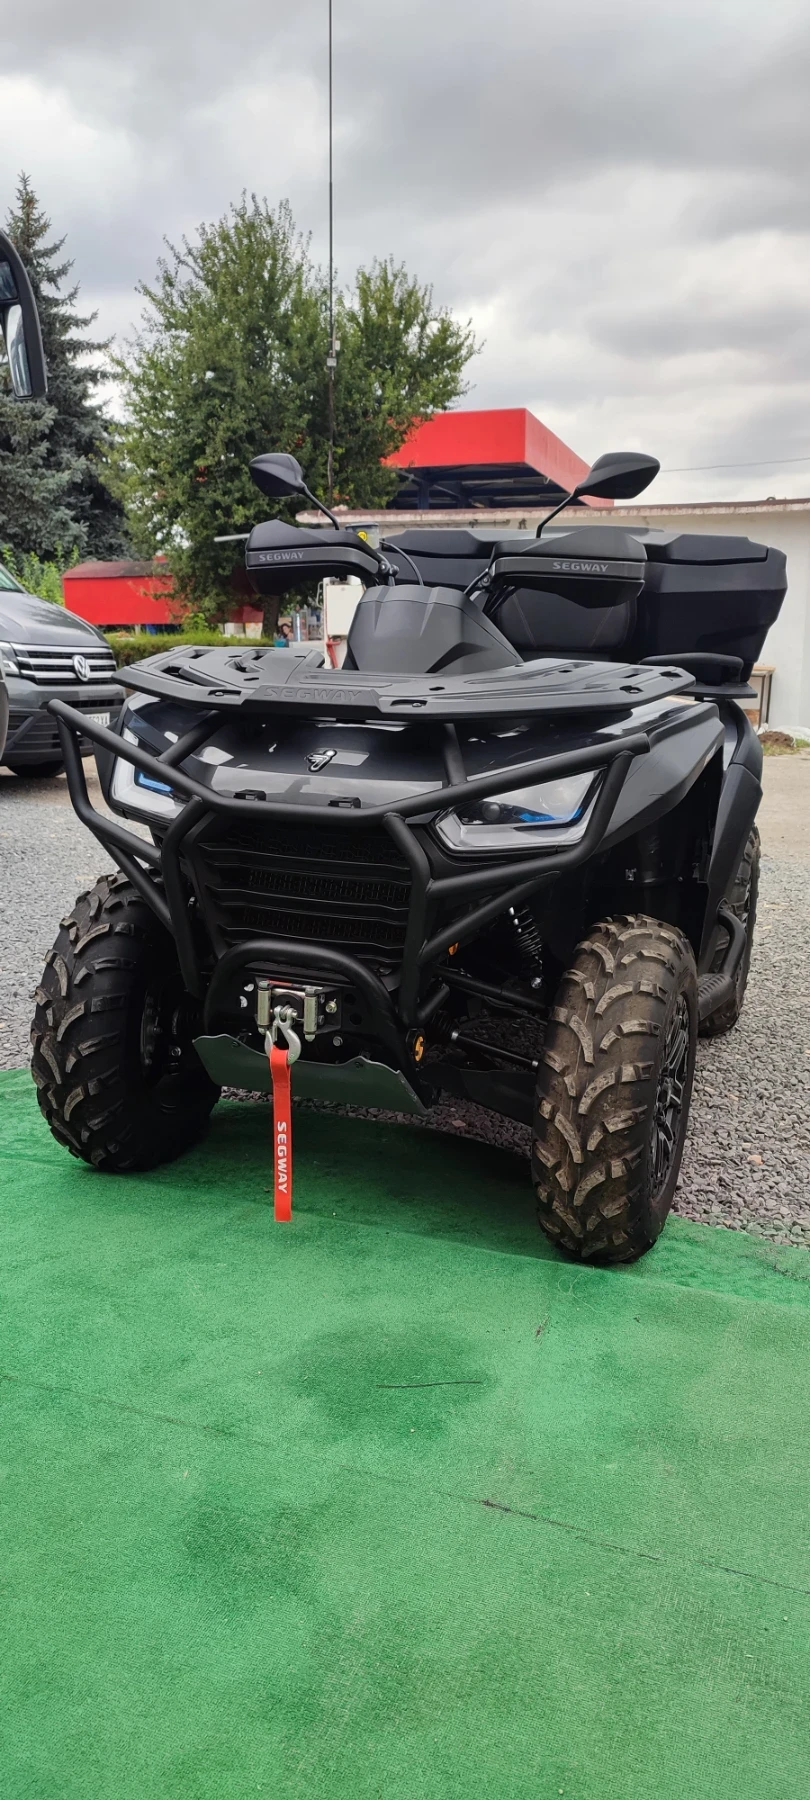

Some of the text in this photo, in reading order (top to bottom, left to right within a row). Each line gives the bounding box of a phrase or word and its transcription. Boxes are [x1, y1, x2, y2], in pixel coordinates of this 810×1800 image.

[259, 551, 304, 562] SEGWAY
[553, 561, 609, 572] SEGWAY
[263, 687, 361, 701] SEGWAY
[277, 1121, 288, 1194] SEGWAY
